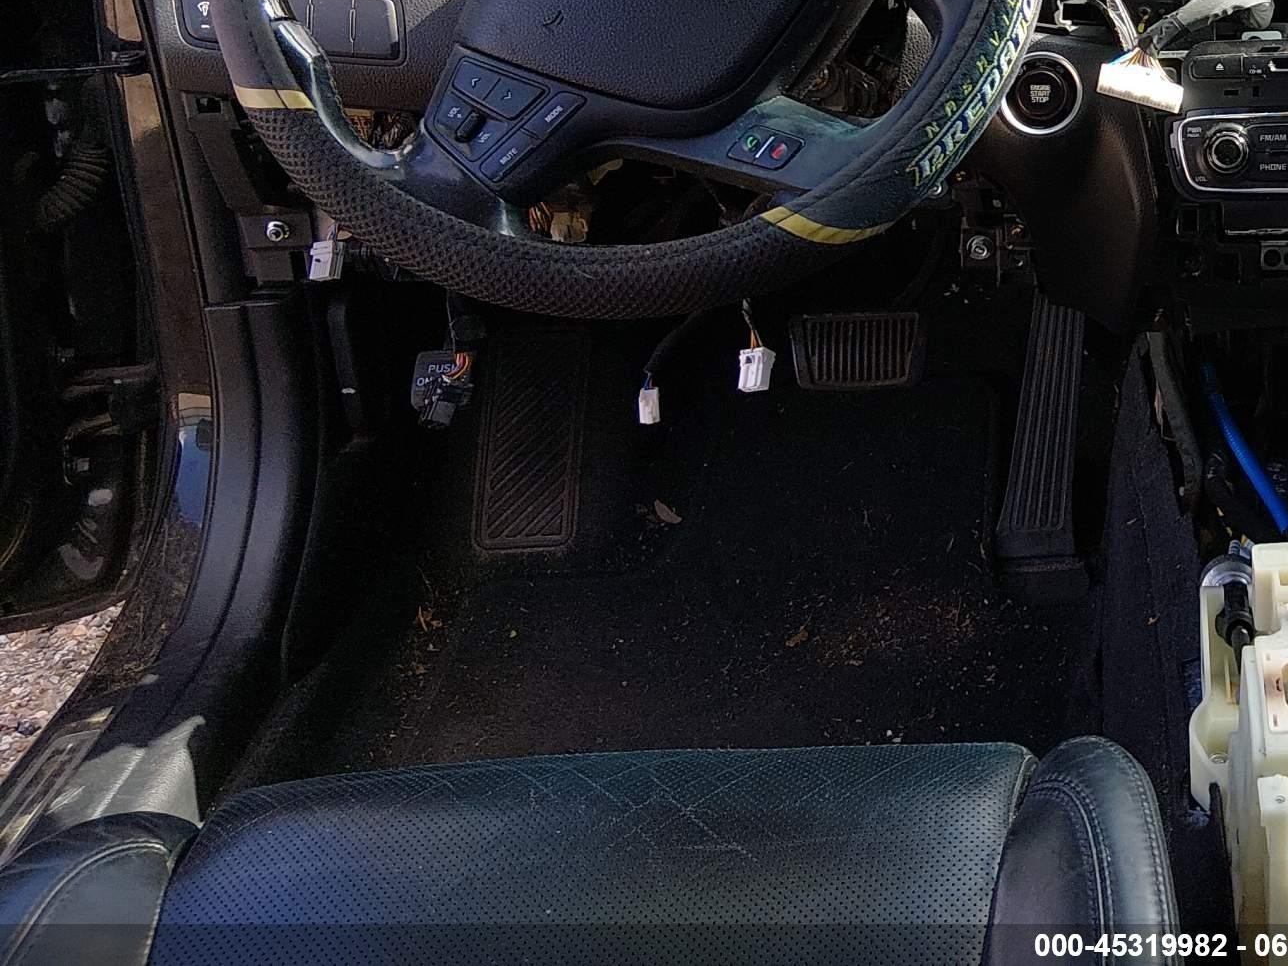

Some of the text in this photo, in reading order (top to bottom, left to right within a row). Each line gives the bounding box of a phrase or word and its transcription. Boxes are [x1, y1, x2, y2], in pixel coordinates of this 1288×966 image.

[544, 105, 564, 123] MODE
[1259, 133, 1287, 142] FM/AM
[500, 148, 519, 165] MUTE
[1259, 163, 1287, 171] PHONE
